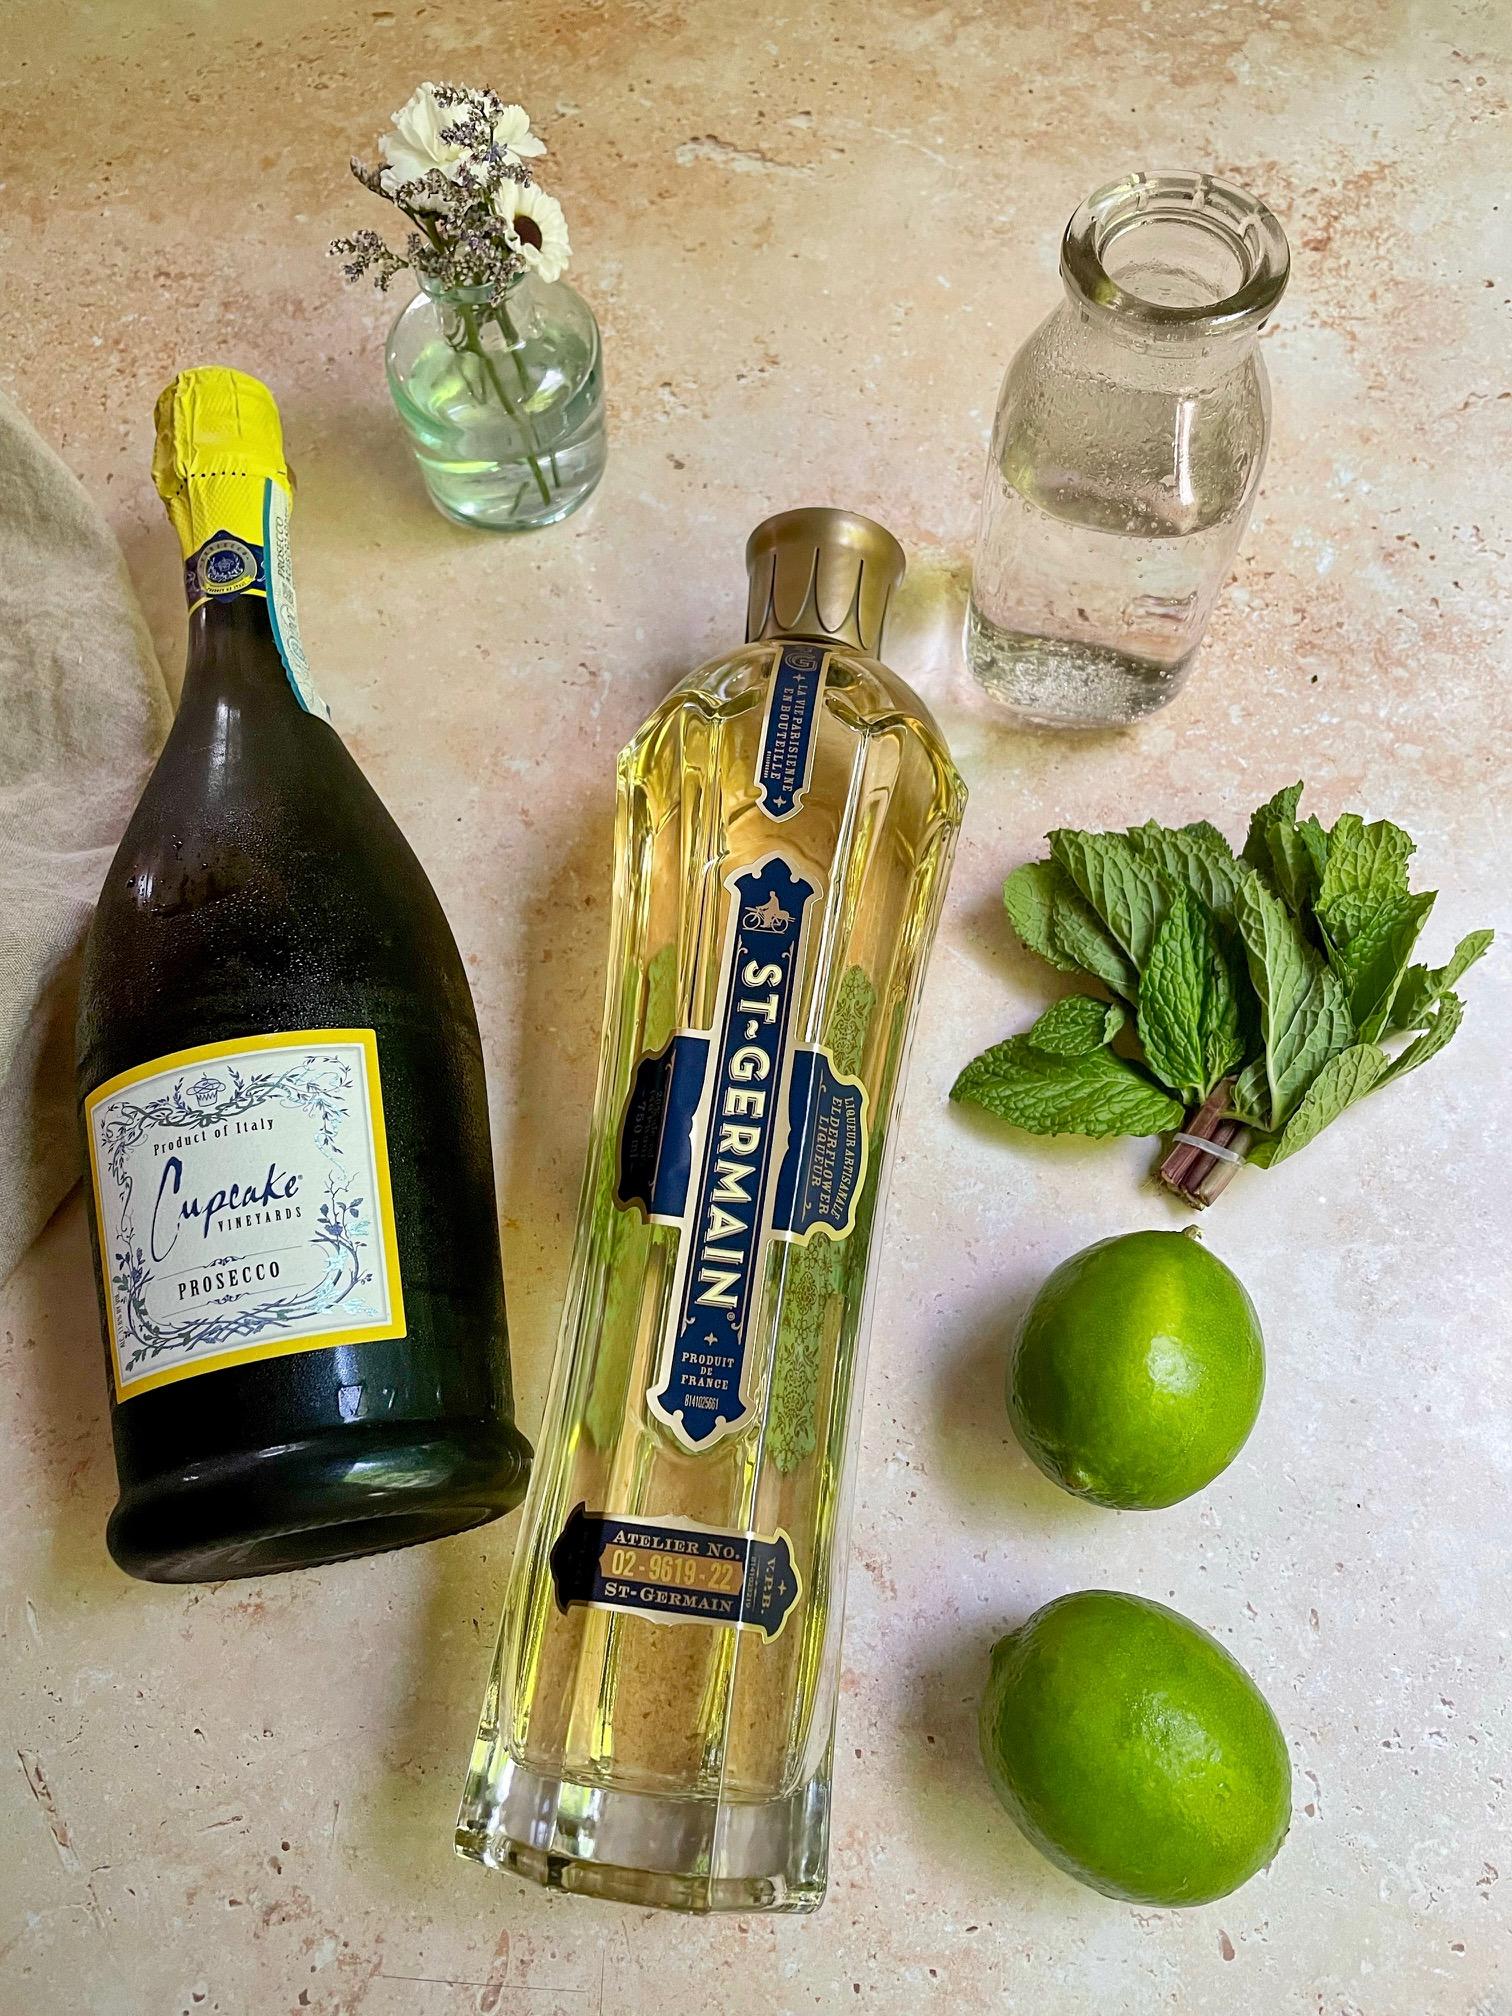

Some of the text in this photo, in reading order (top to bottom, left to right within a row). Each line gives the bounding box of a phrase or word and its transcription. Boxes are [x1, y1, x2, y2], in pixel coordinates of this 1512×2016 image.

[276, 516, 286, 578] PROSECCO
[770, 687, 794, 781] EN BOUTEILLE
[782, 684, 808, 793] LA VIE PARISIENNE
[153, 1118, 275, 1156] Product of Italy
[811, 1114, 829, 1187] LIQUEUR
[818, 1096, 843, 1215] ELDERFLOWER
[831, 1096, 857, 1221] LIQUEUR ARTISANALE
[151, 1156, 299, 1263] Cupcake
[217, 1206, 302, 1233] VINEYARDS
[178, 1261, 281, 1301] PROSECCO
[681, 1352, 735, 1368] PRODUIT
[700, 1366, 713, 1376] DE
[680, 1374, 729, 1390] FRANCE
[613, 1529, 699, 1554] ATELIER
[604, 1580, 733, 1613] ST-GERMAIN
